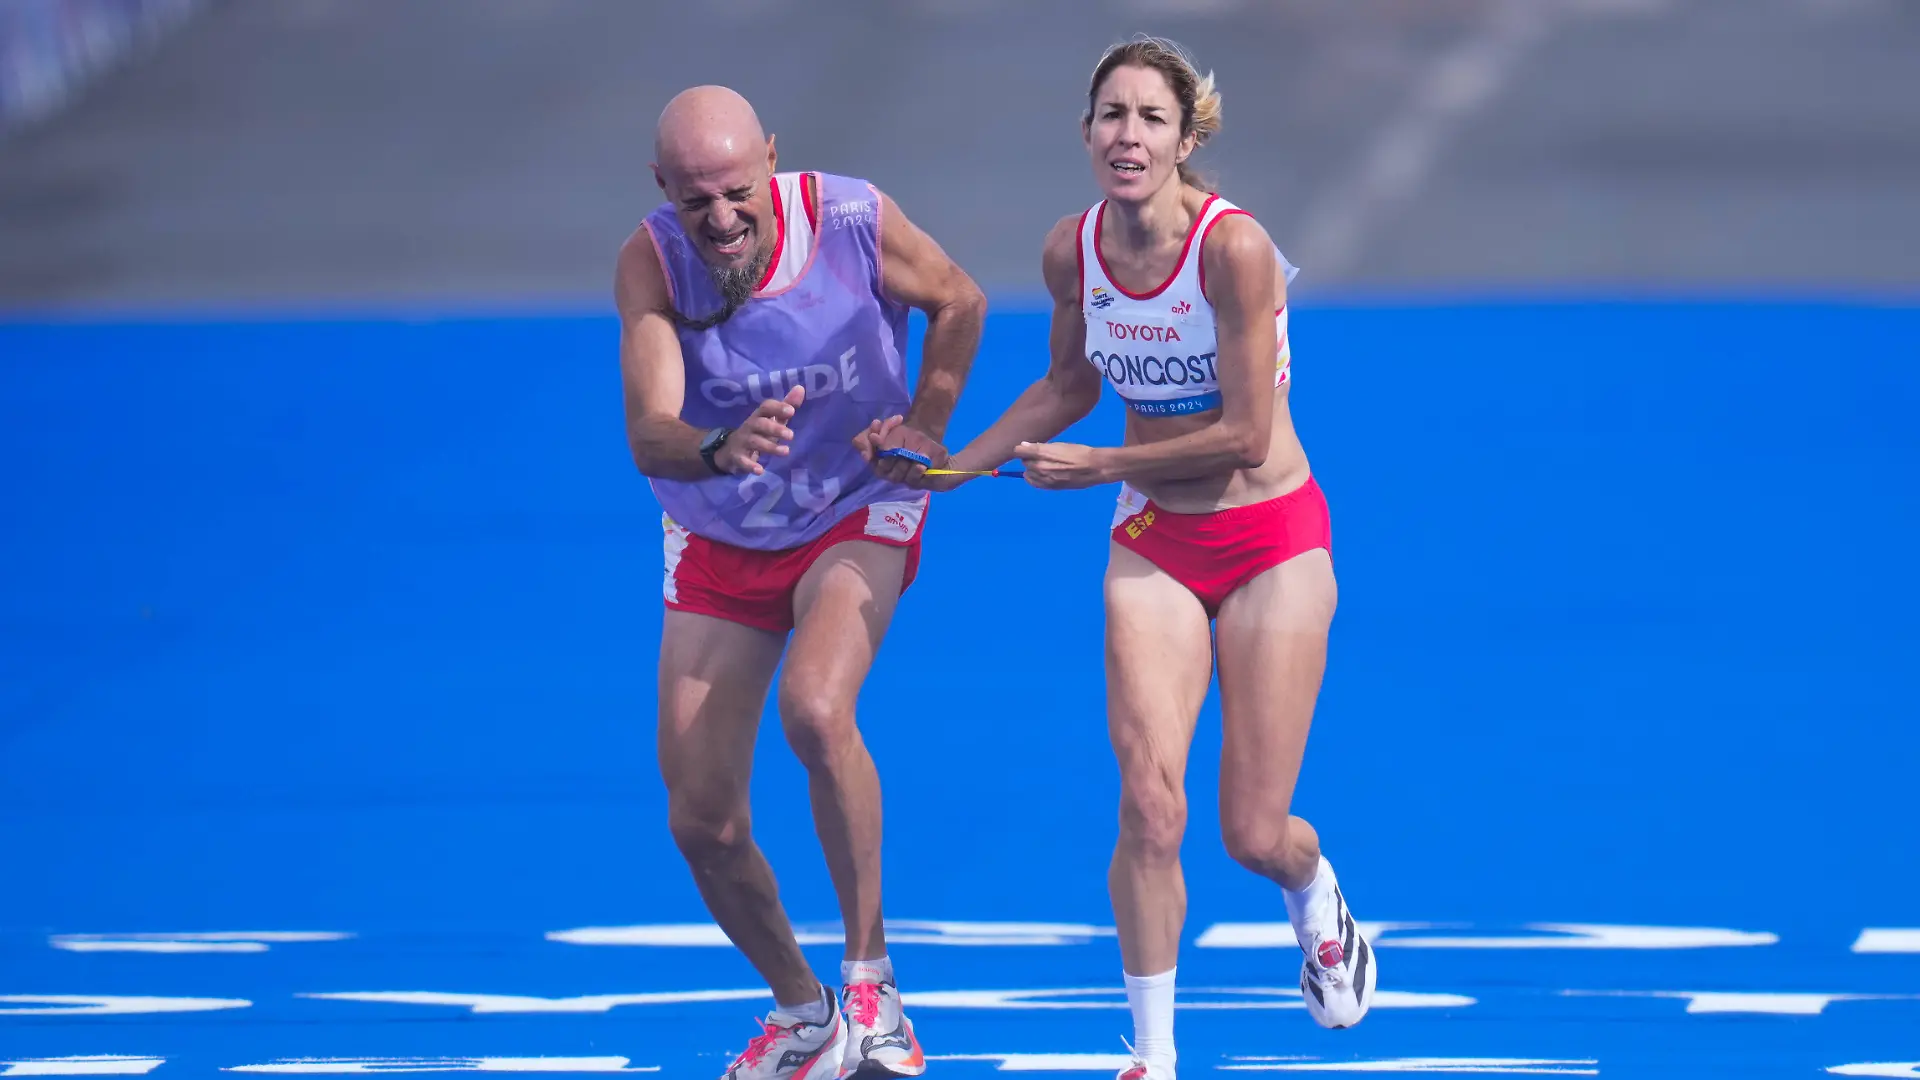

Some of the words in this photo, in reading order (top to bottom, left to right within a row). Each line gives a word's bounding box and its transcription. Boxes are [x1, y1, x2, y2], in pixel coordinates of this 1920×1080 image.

[830, 200, 871, 217] PARIS
[832, 214, 871, 230] 2024
[1106, 321, 1181, 343] TOYOTA
[701, 345, 860, 409] GUIDE
[1134, 403, 1166, 413] PARIS
[1169, 400, 1204, 413] 2024
[737, 468, 840, 528] 24
[1125, 511, 1155, 540] ESP
